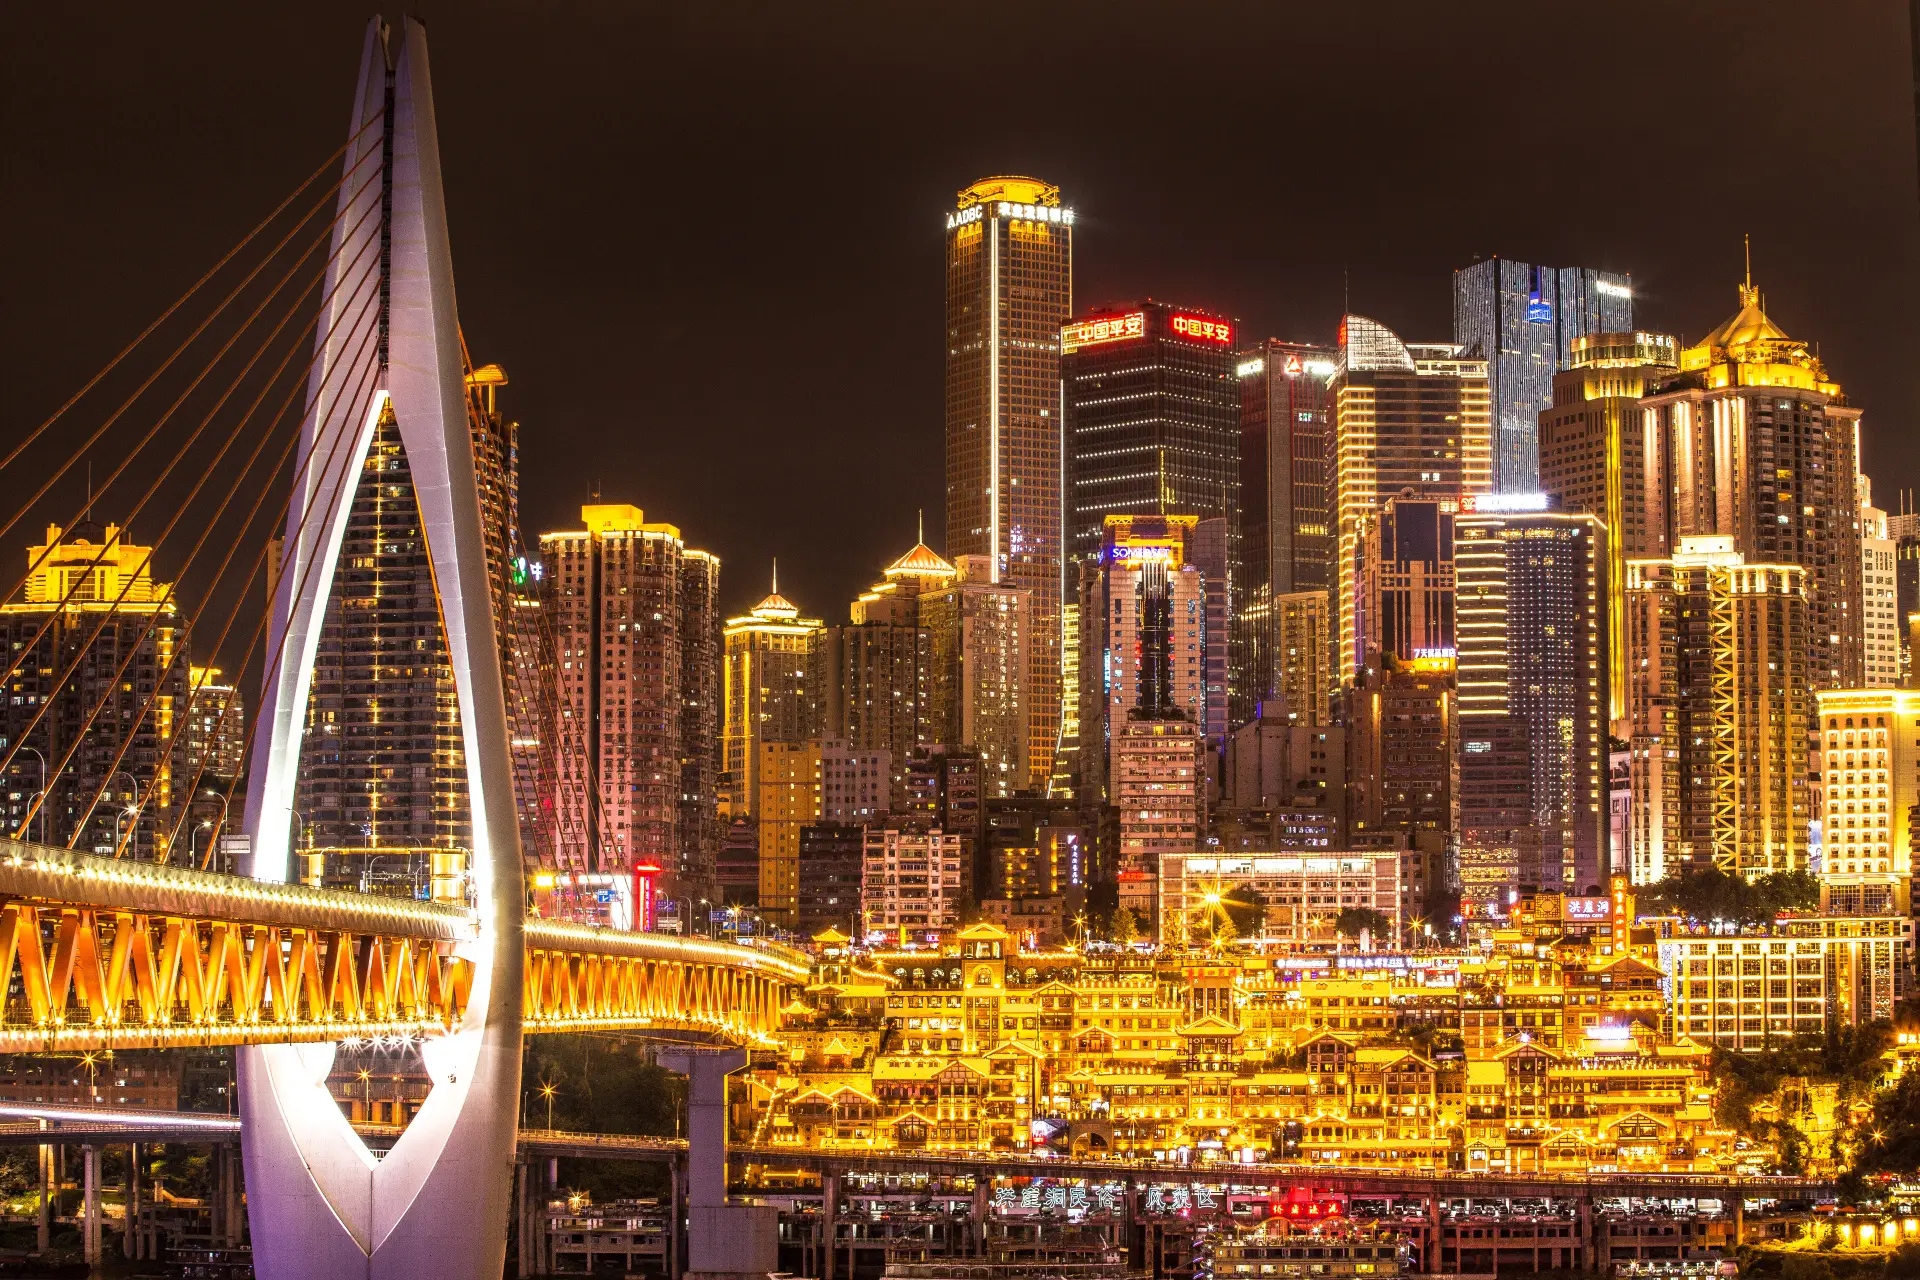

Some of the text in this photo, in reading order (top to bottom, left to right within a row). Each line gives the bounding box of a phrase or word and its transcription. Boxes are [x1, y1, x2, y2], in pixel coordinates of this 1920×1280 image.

[1079, 316, 1141, 342] 中国平安
[1173, 316, 1230, 342] 中国平安
[1568, 900, 1609, 914] 洪崖洞
